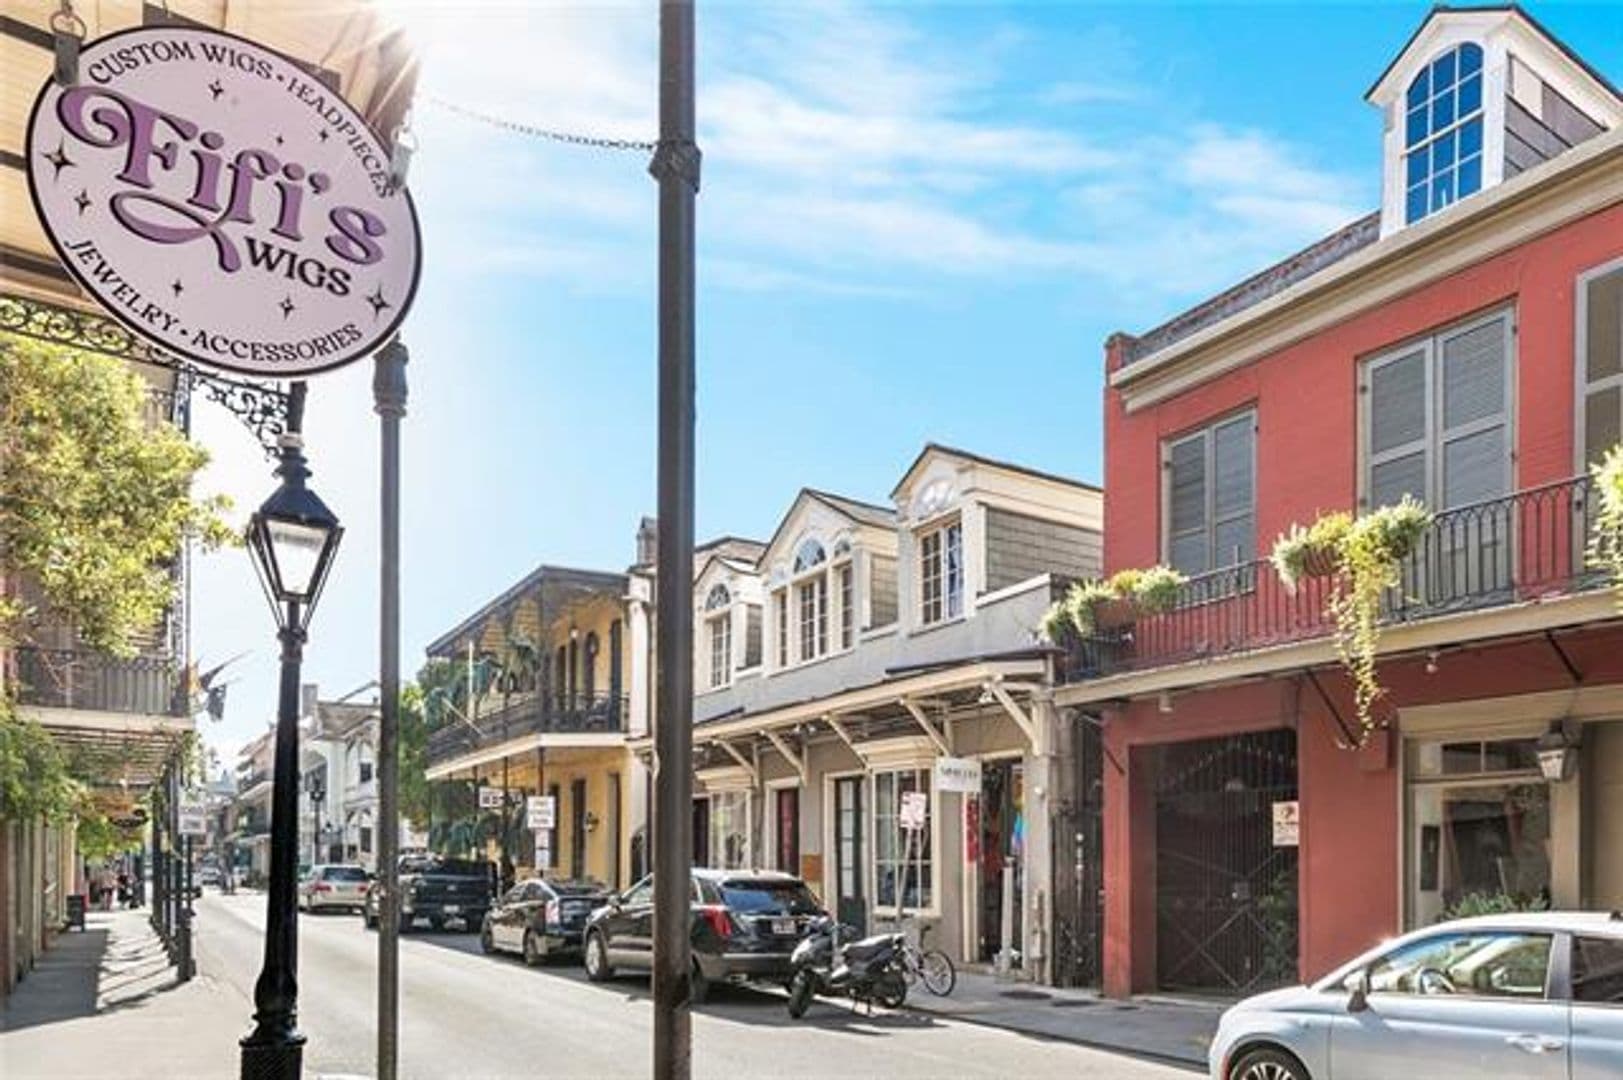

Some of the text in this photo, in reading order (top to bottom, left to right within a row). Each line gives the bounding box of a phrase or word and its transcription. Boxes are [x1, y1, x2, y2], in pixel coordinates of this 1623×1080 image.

[88, 41, 195, 84] CUSTOM
[200, 43, 273, 80] WIGS
[56, 85, 387, 273] Fifi's
[64, 239, 363, 362] JEWELRY ACCESSORIES
[244, 236, 351, 296] WIGS
